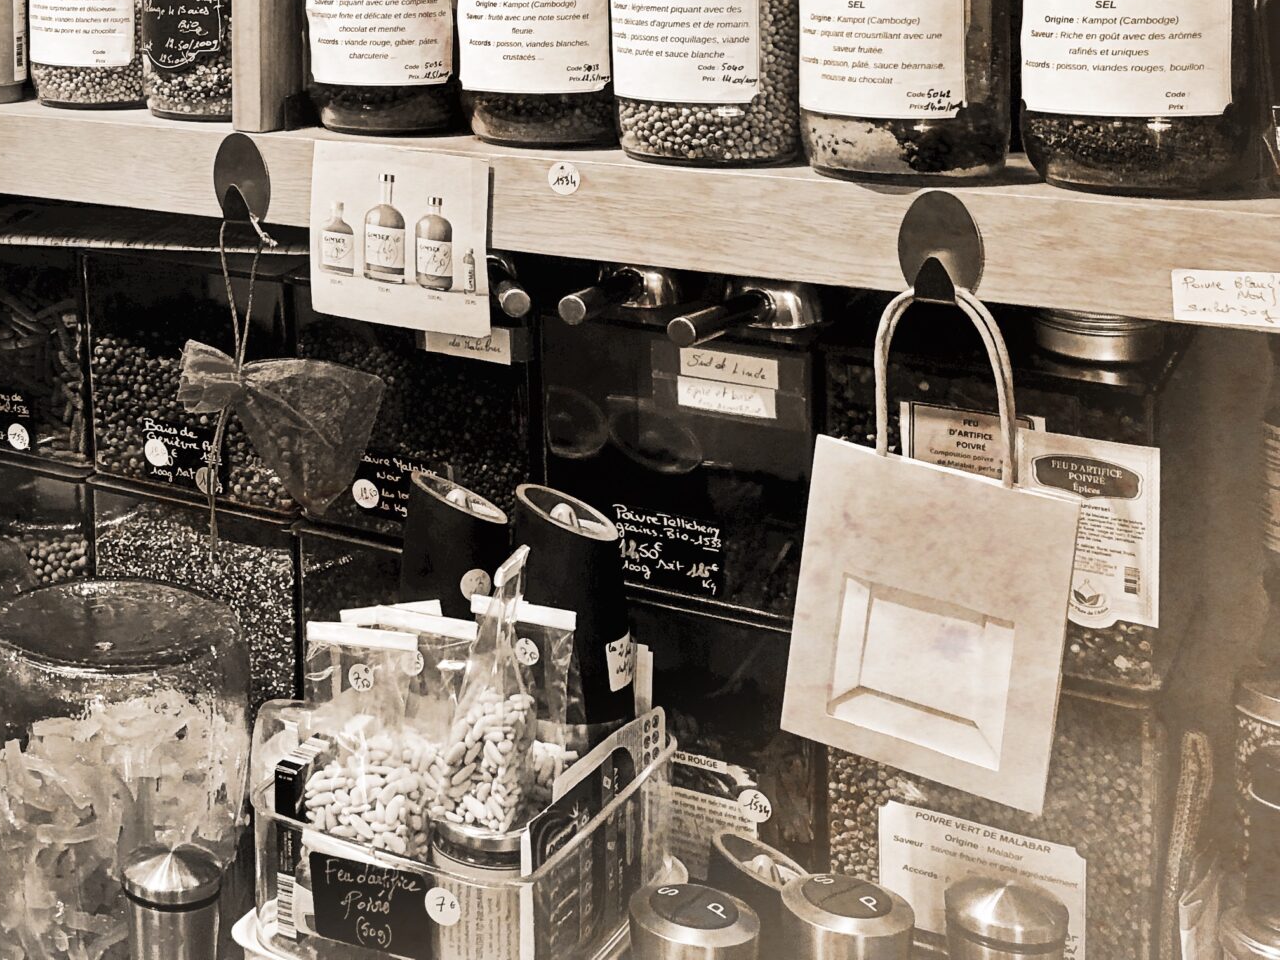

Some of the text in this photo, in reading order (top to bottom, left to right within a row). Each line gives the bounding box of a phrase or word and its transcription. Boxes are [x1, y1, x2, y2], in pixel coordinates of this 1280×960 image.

[503, 0, 576, 9] Kampot (Cambodge)
[670, 5, 701, 14] piquant
[1095, 1, 1117, 9] SEL
[650, 20, 690, 29] d'agrumes
[837, 15, 920, 25] Kampot (Cambodge)
[1045, 15, 1179, 26] Origine Kampot (Cambodge)
[1031, 30, 1053, 38] Saveur
[1060, 31, 1084, 39] Riche
[1149, 32, 1165, 40] des
[1111, 49, 1149, 57] uniques
[1056, 63, 1204, 73] poisson, viandes rouges, bouillon
[963, 419, 979, 427] FEU
[180, 426, 198, 438] de
[949, 429, 993, 441] D'ARTIFICE
[956, 440, 986, 451] POIVRÉ
[929, 448, 994, 464] Composition poivre
[1051, 459, 1123, 479] FEU D'ARTIFICE
[1068, 471, 1105, 485] POIVRÉ
[1073, 483, 1100, 495] Épices
[916, 811, 1051, 854] POIVRE VERT DE MALABAR
[894, 835, 924, 848] Saveur
[945, 835, 1023, 862] Origine Malabar
[325, 859, 354, 884] Feu
